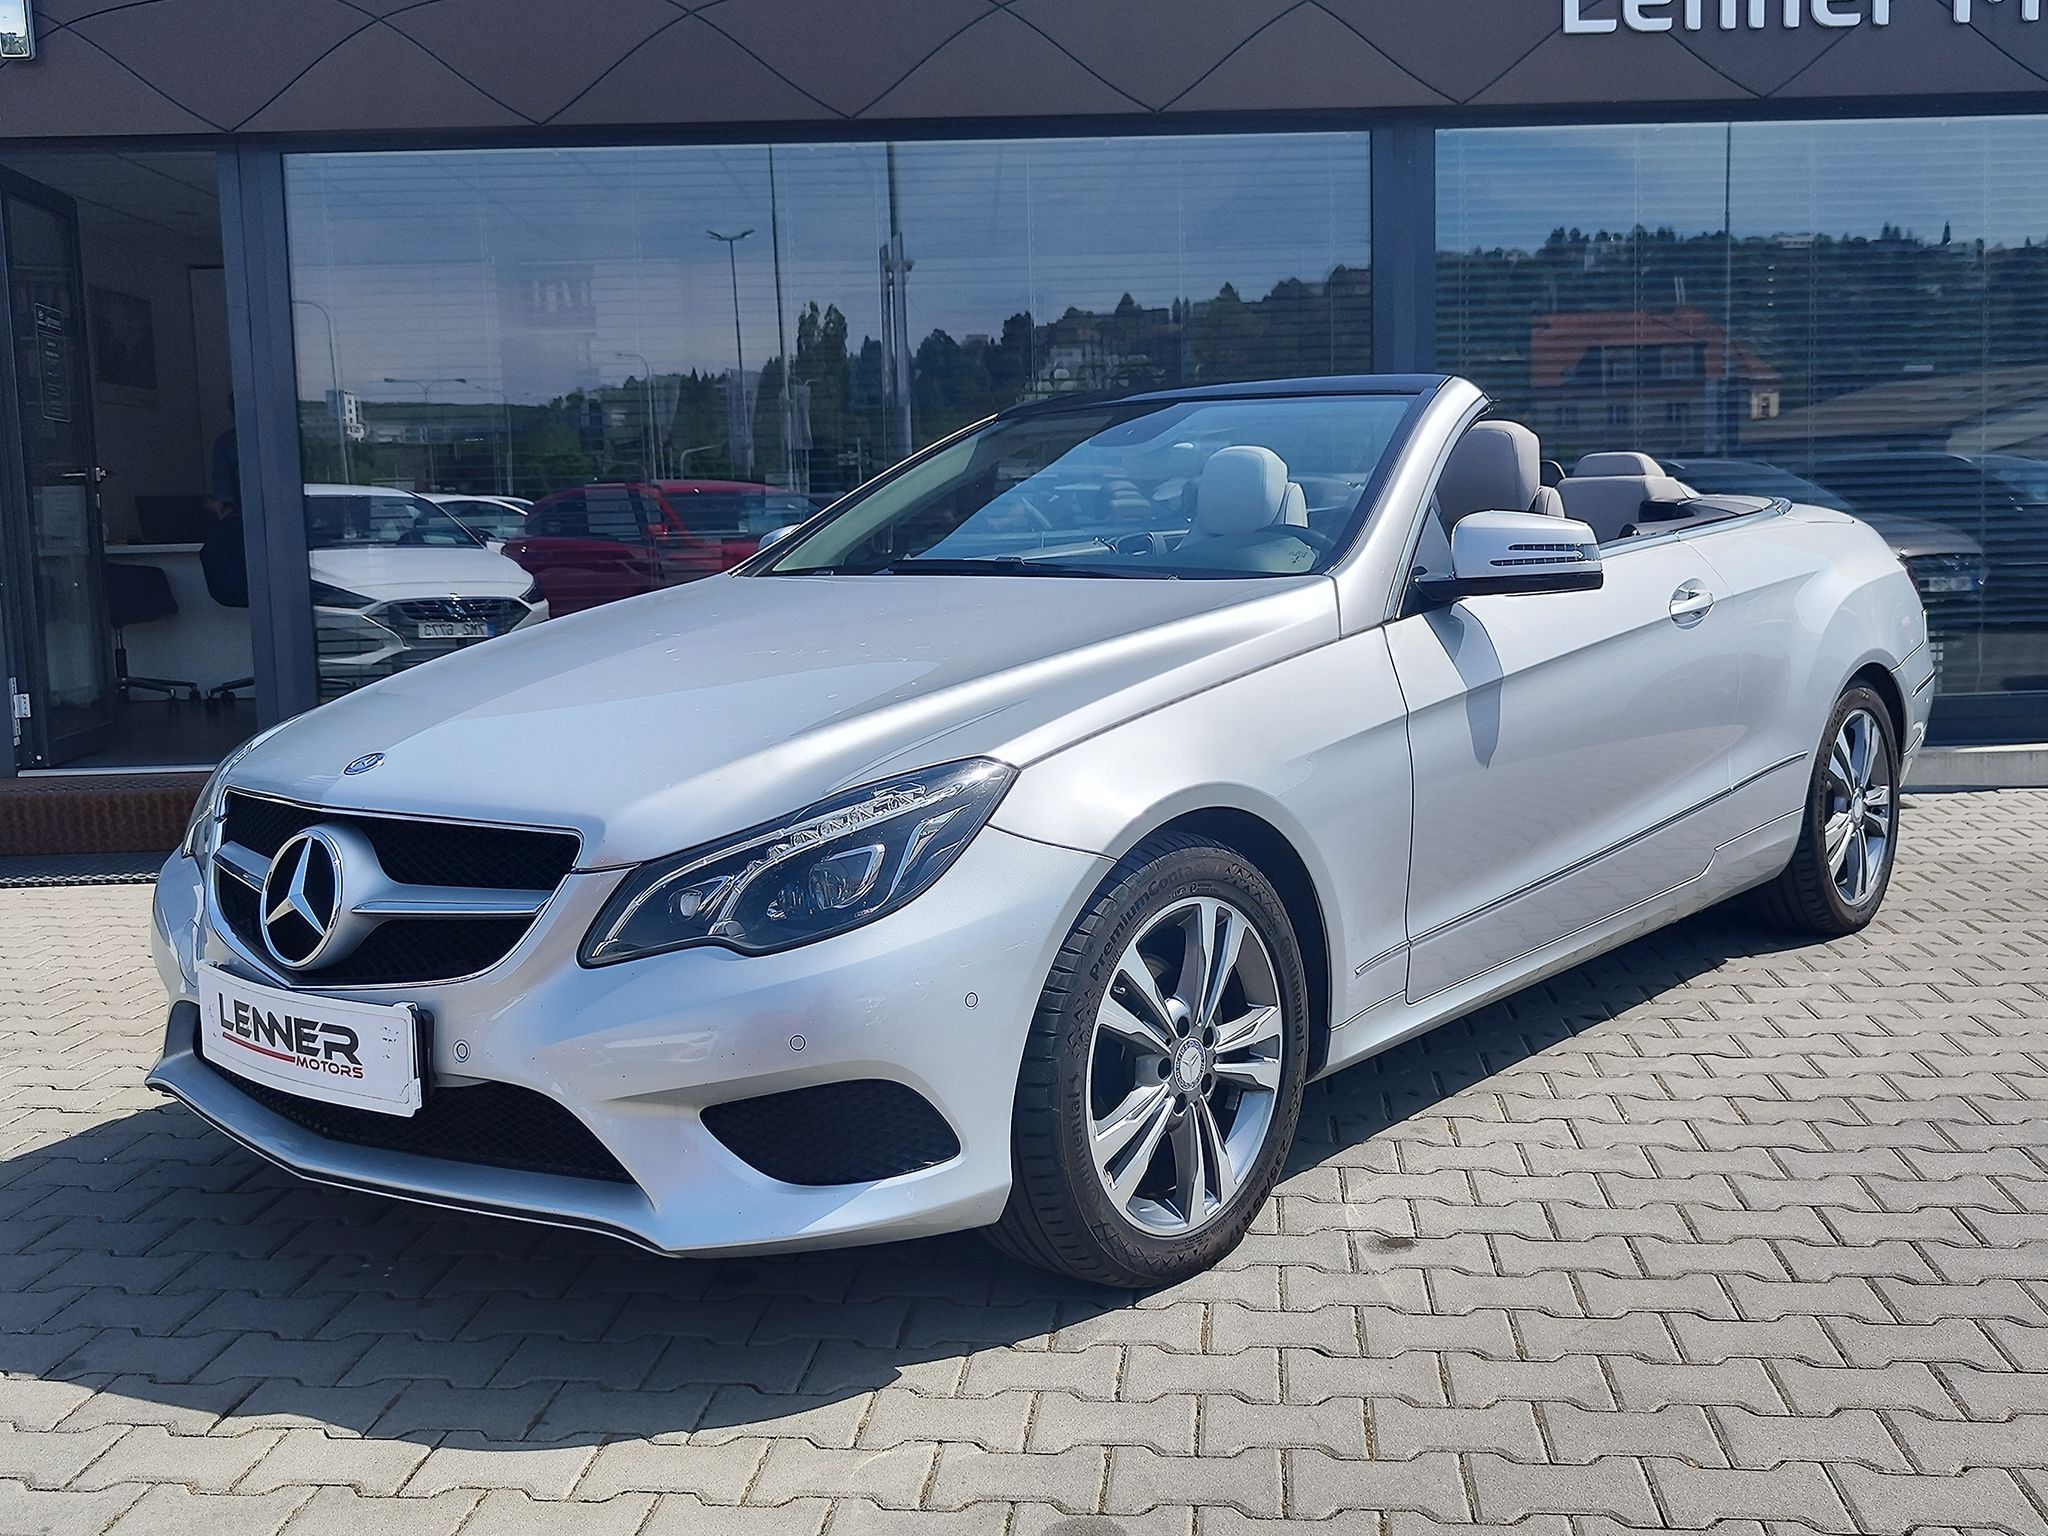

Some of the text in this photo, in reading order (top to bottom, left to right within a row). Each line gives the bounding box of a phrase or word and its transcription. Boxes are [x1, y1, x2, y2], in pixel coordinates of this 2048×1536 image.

[1089, 862, 1209, 981] PremiumContac
[218, 992, 363, 1066] LENNER
[296, 1056, 363, 1079] MOTORS
